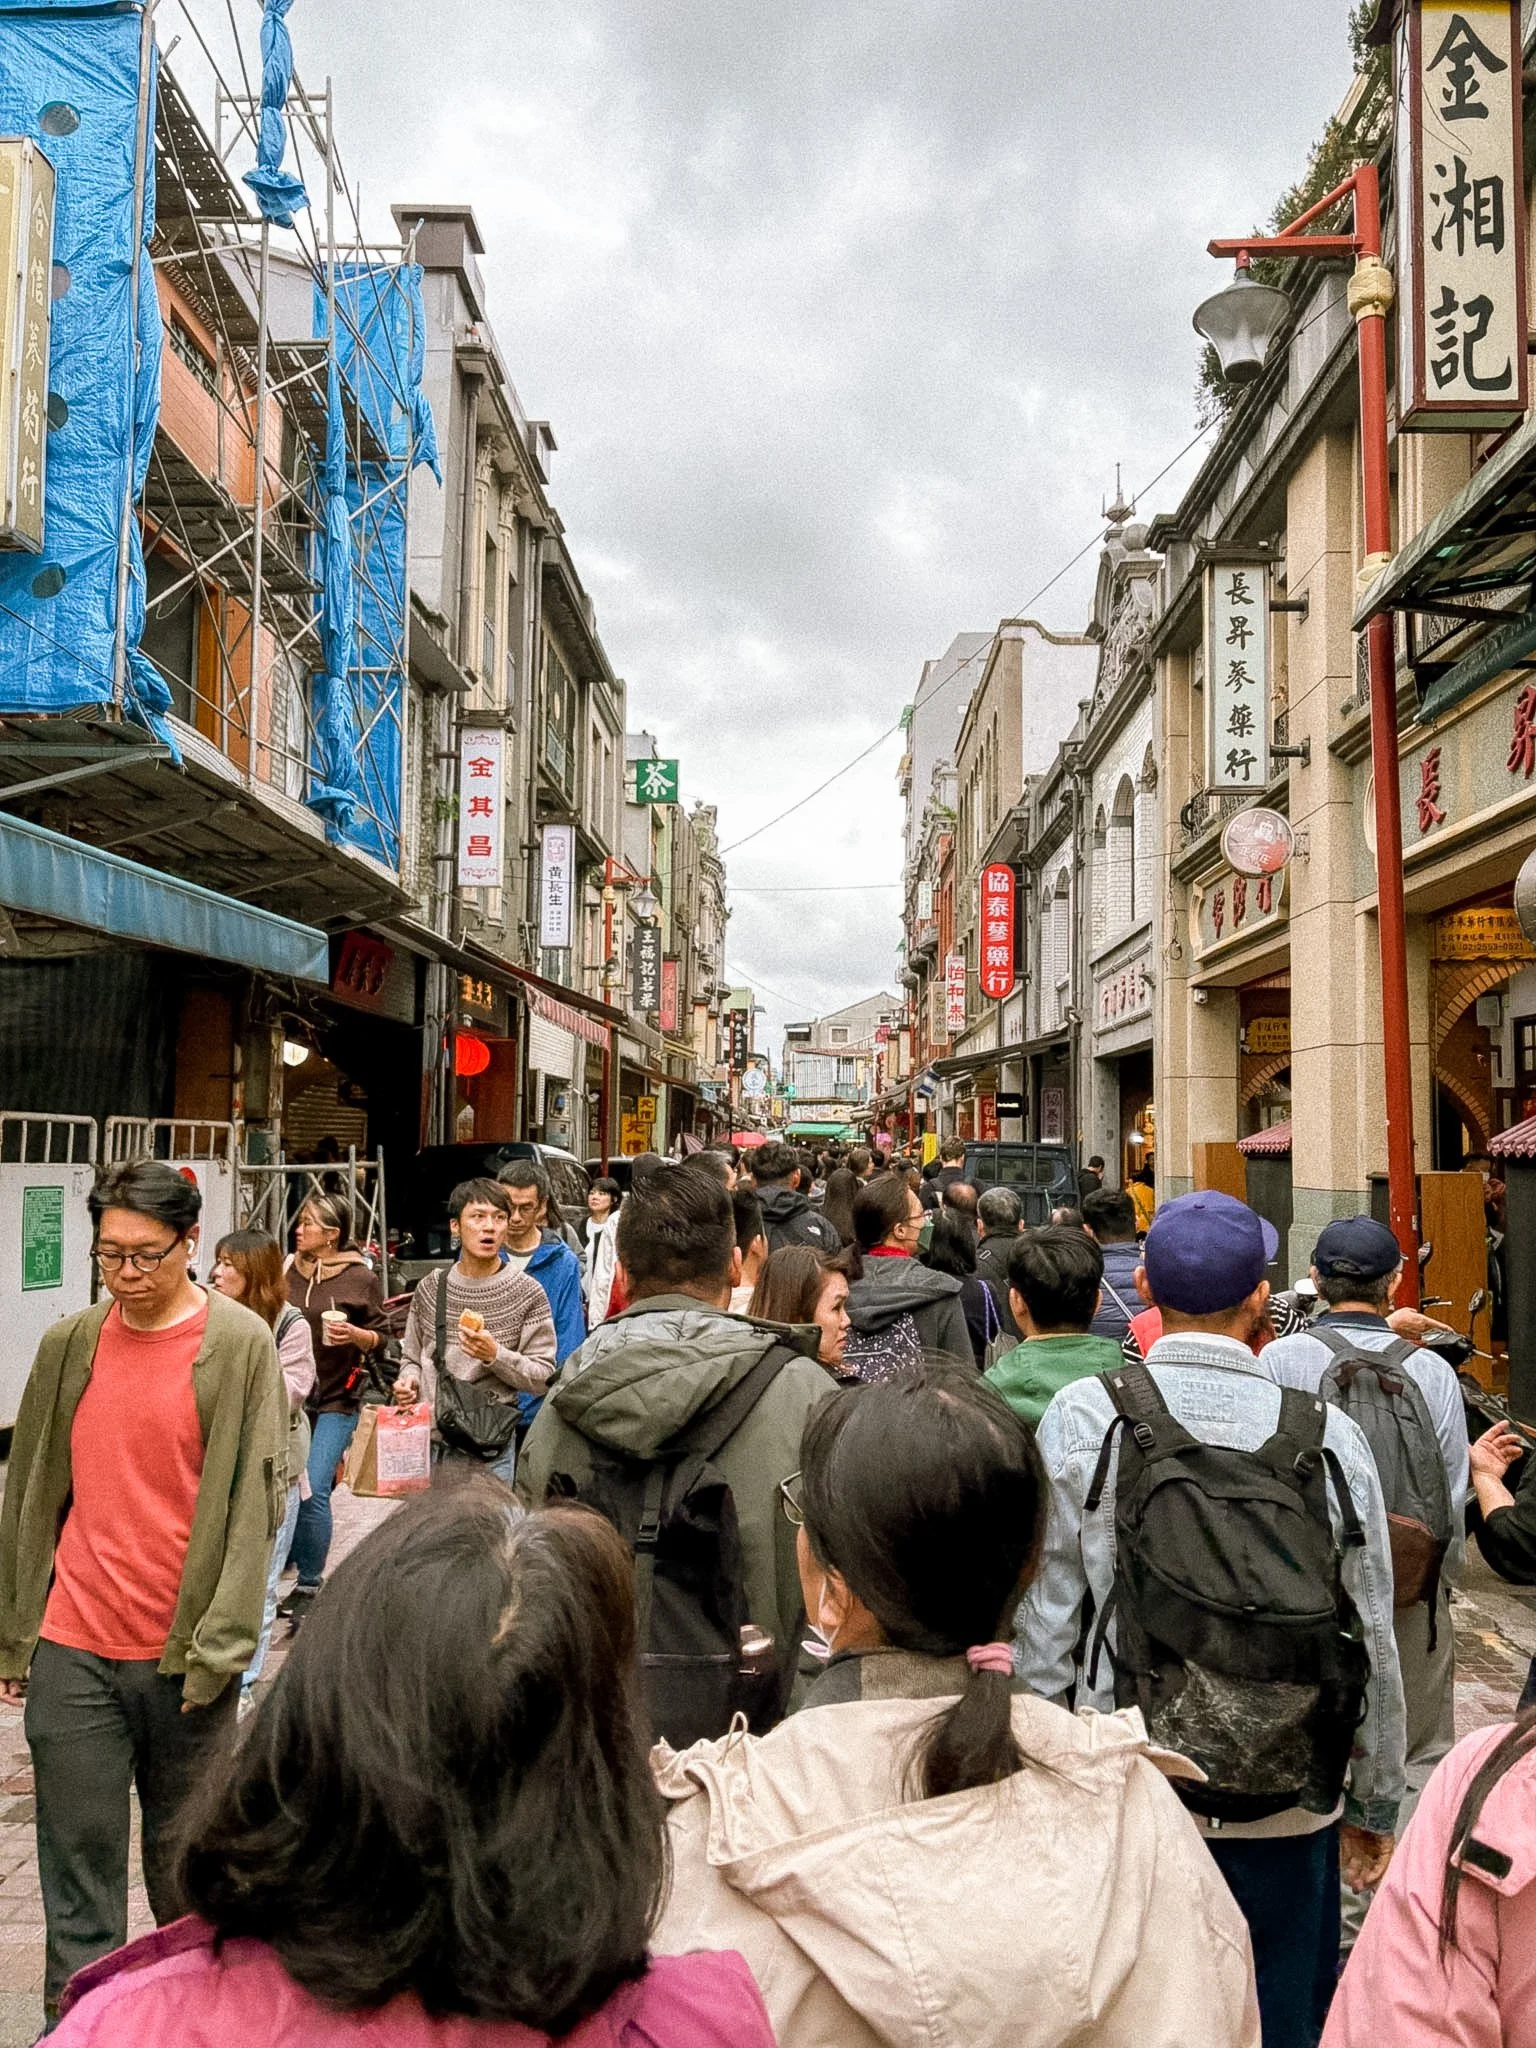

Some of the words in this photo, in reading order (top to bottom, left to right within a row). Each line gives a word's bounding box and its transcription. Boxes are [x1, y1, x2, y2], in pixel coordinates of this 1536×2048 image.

[1426, 14, 1512, 391] 金湘記
[466, 756, 496, 858] 金其昌
[641, 762, 676, 799] 茶
[947, 965, 966, 1023] 怡和泰
